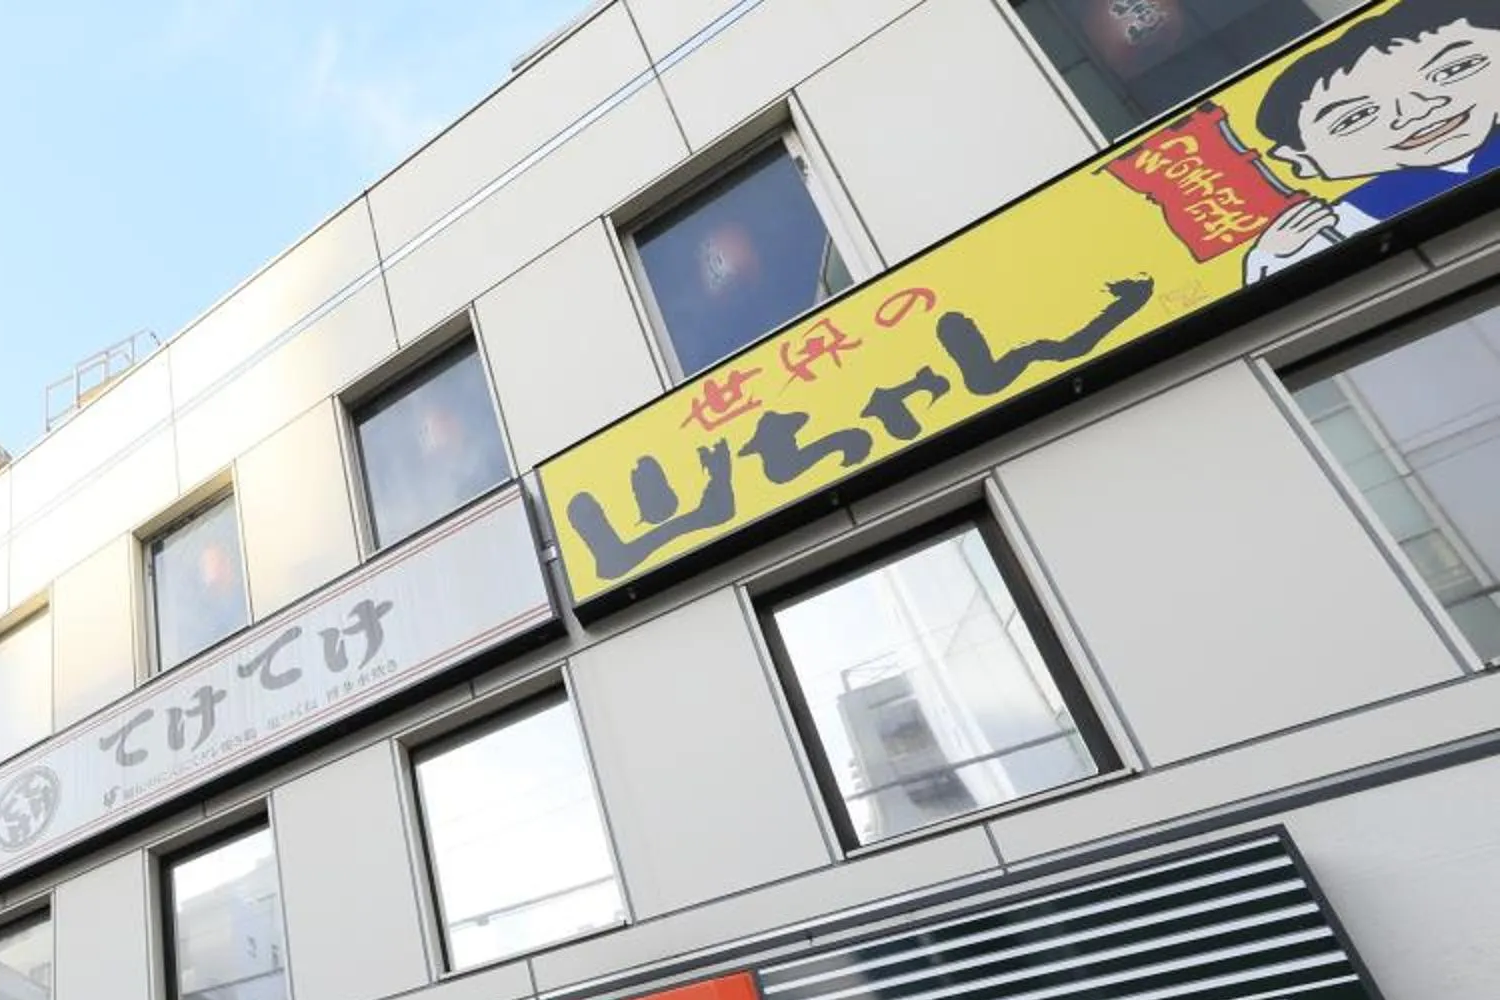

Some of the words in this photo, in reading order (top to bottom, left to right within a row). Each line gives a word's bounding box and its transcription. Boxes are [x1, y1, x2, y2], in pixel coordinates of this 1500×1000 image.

[566, 271, 1155, 581] 山ちゃん
[681, 286, 938, 432] 世界の
[99, 599, 395, 768] てけてけ
